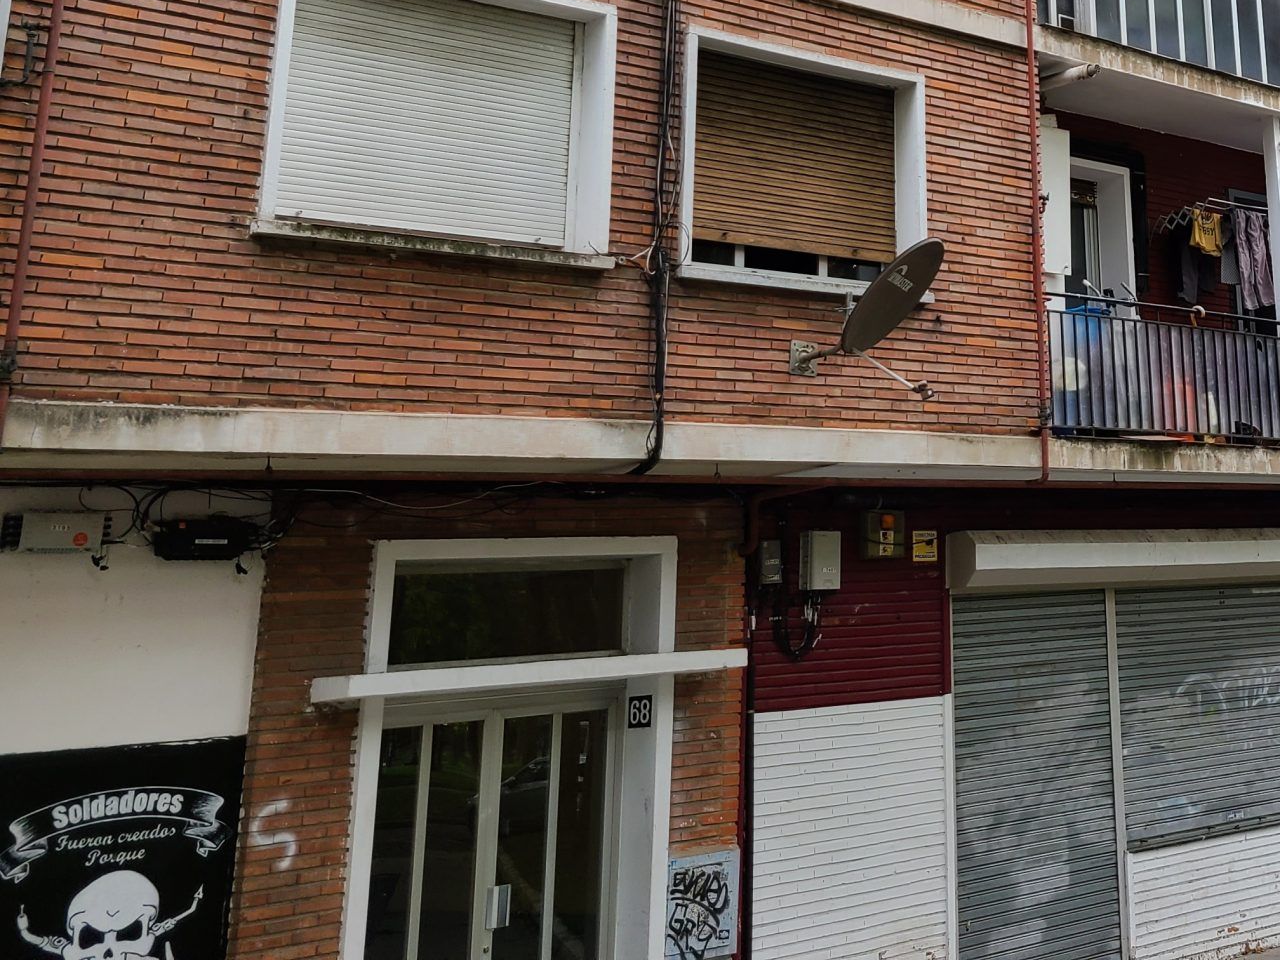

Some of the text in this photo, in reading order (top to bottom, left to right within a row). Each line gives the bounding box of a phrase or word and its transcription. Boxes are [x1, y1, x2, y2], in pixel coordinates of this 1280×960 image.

[629, 699, 650, 725] 68
[51, 790, 185, 830] Soldadores
[55, 824, 177, 852] Fueron creados
[85, 848, 146, 867] Porque
